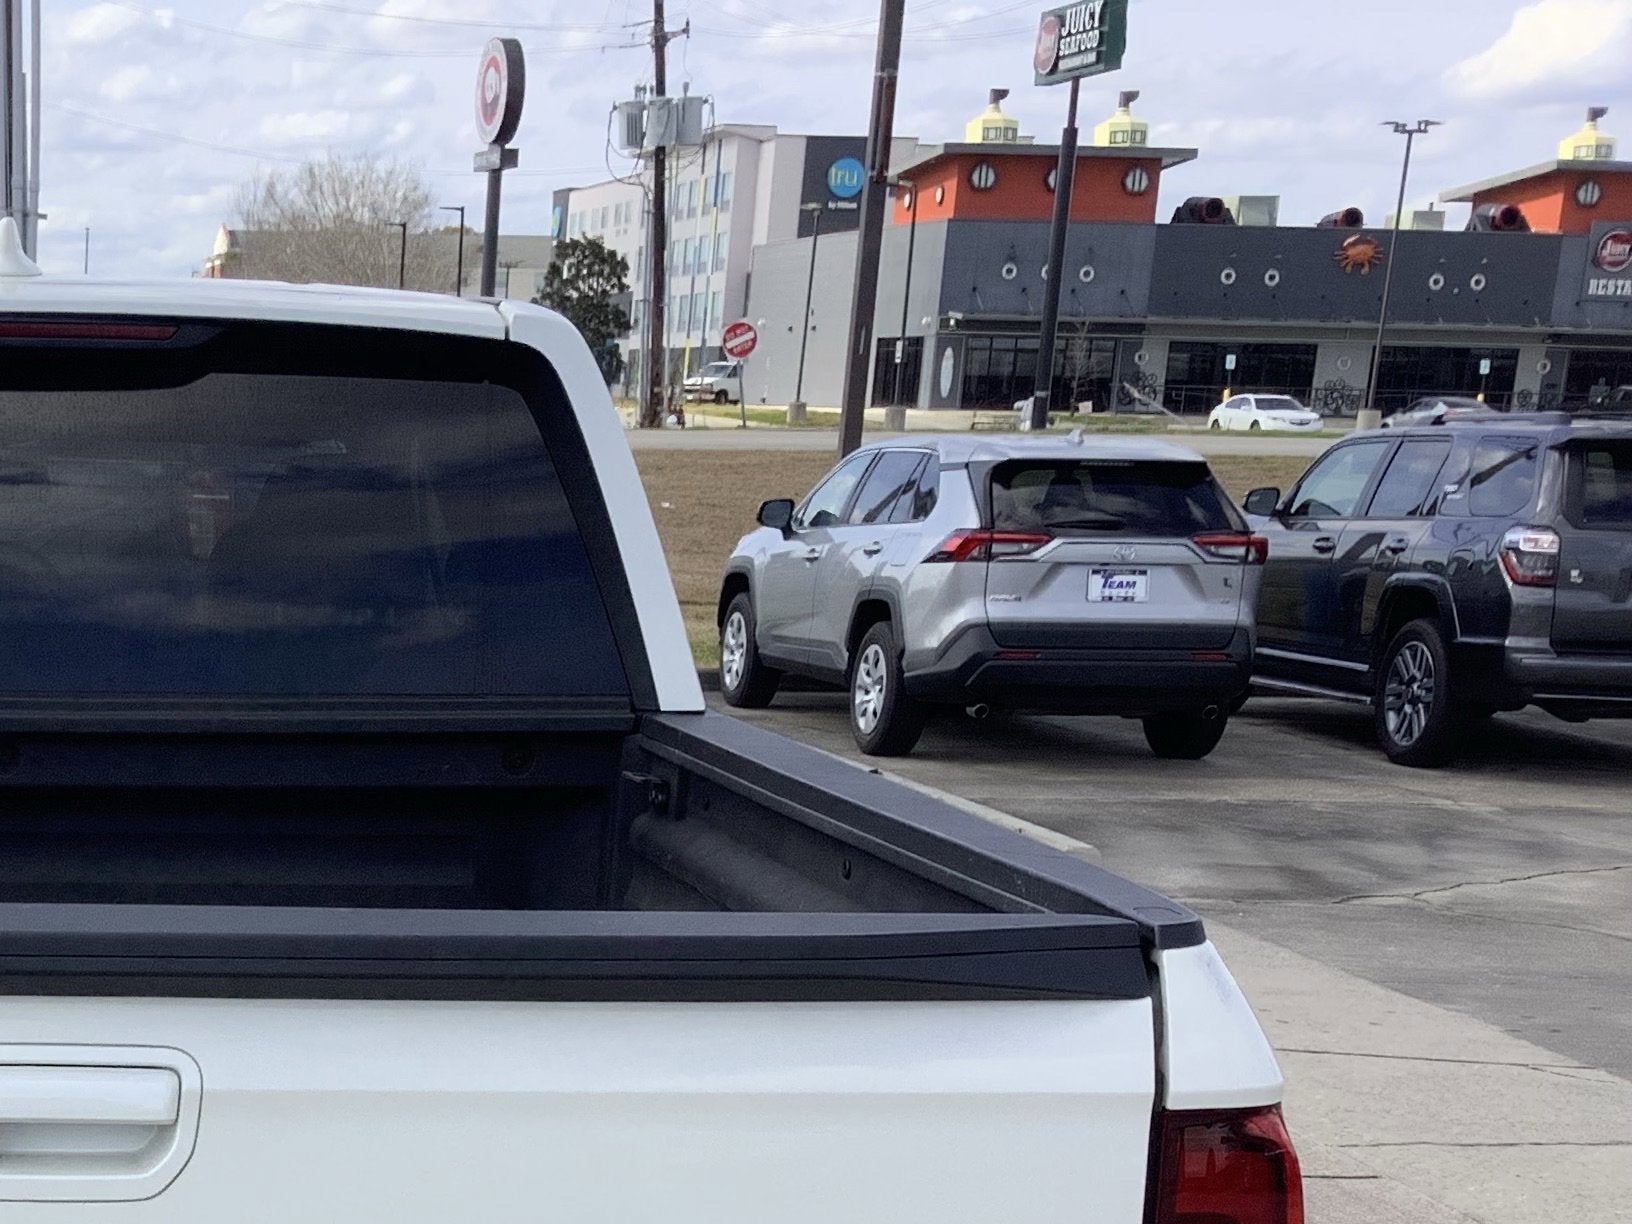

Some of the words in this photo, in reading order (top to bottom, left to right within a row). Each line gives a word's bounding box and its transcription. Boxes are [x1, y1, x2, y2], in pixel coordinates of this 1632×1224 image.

[1061, 0, 1104, 37] JUICY
[1059, 29, 1100, 56] SEAFOOD
[1101, 575, 1137, 590] TEAM
